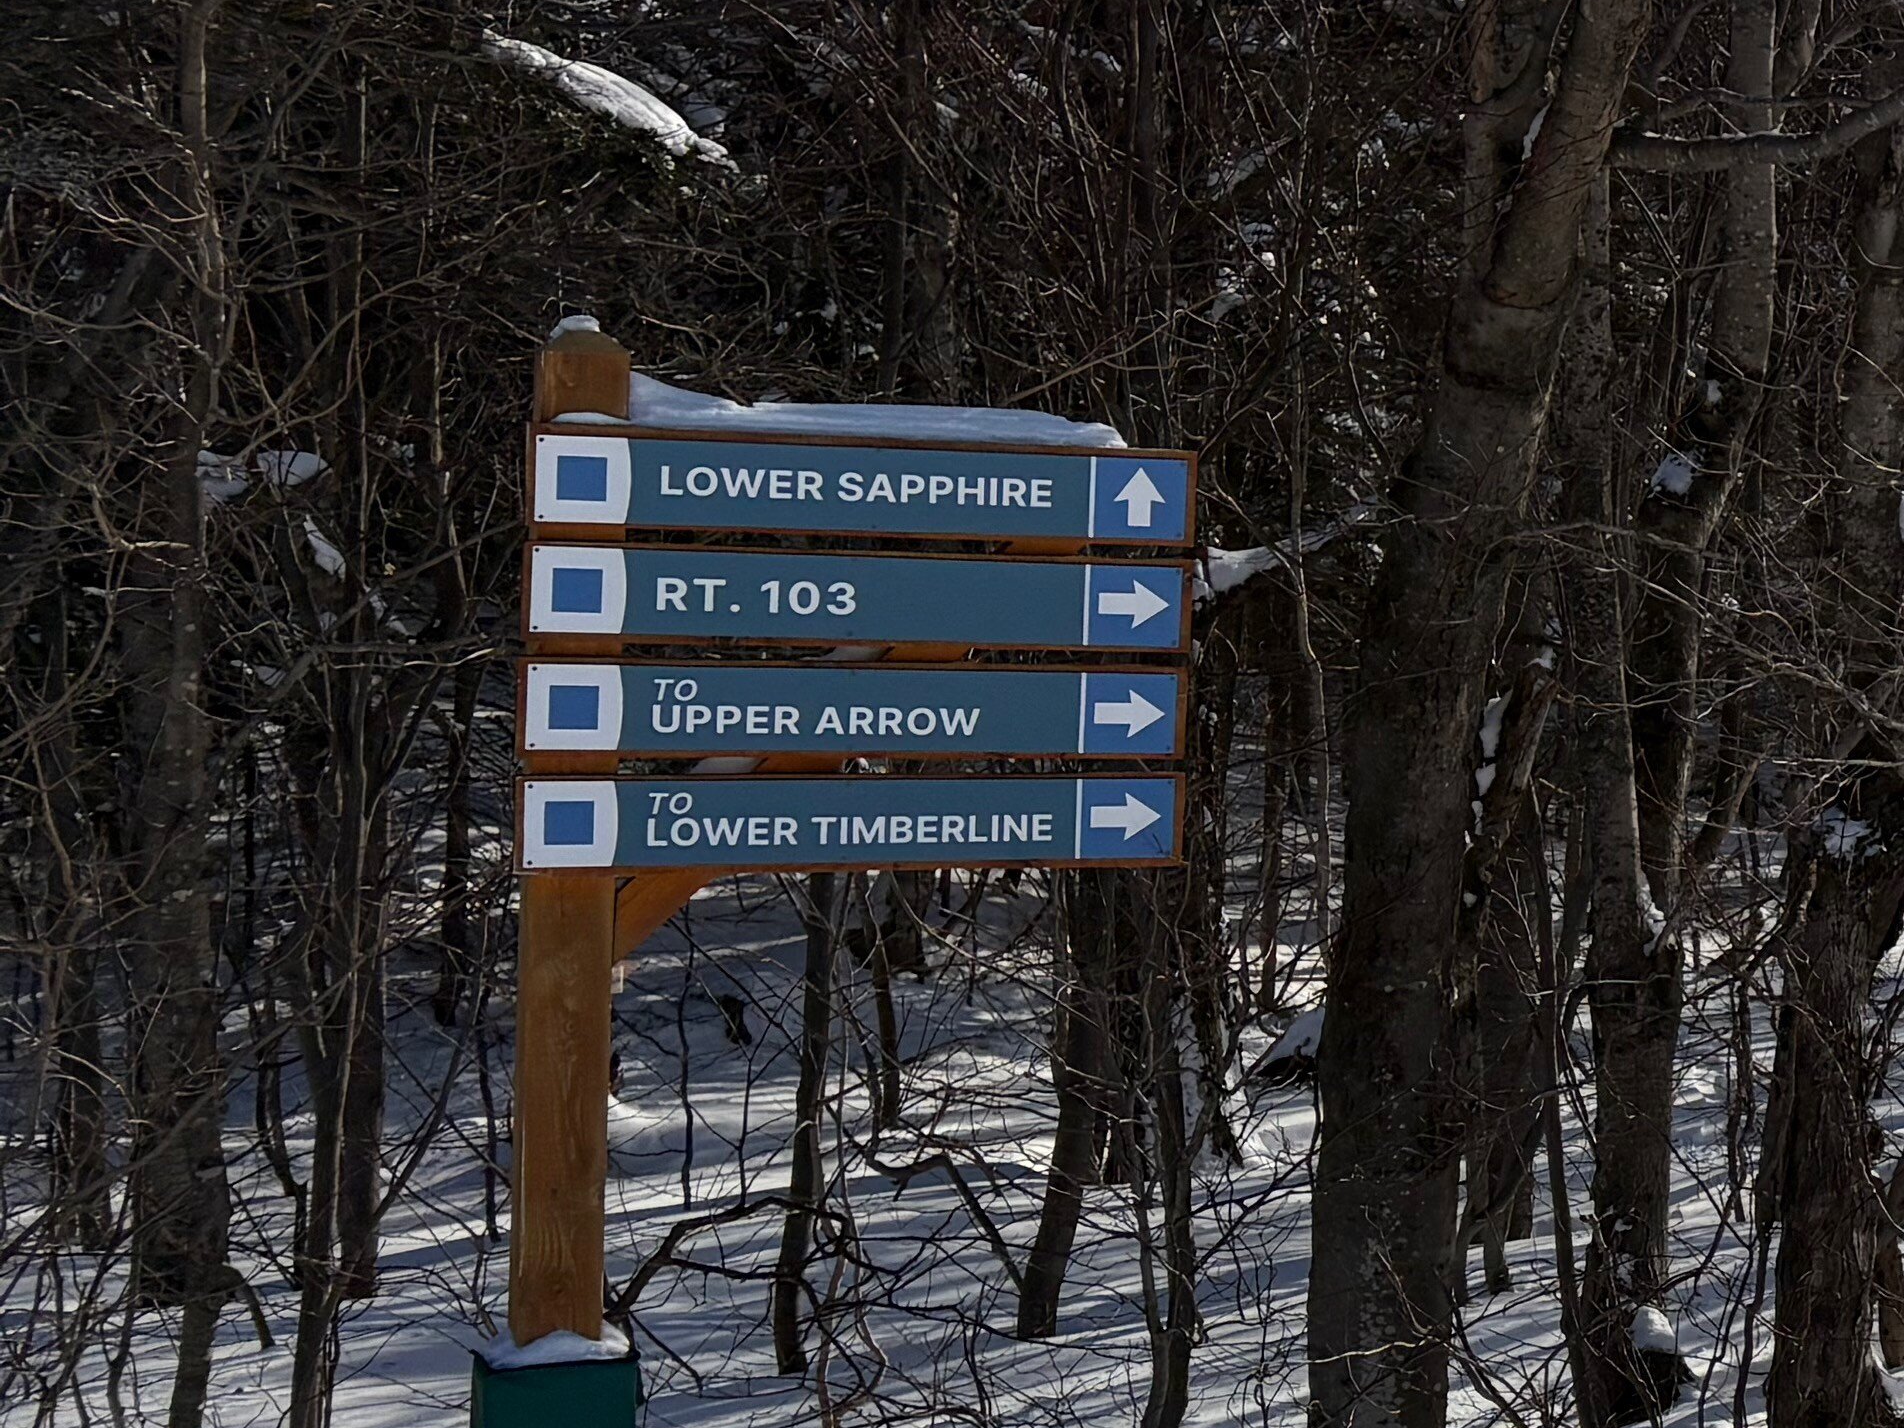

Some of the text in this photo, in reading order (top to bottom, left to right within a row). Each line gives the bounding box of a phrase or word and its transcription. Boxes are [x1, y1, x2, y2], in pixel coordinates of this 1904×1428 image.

[660, 465, 1053, 508] LOWER SAPPHIRE
[656, 577, 856, 615] RT. 103
[654, 678, 698, 701] TO
[652, 704, 981, 736] UPPER ARROW
[648, 792, 693, 815] TO
[647, 814, 1053, 847] LOWER TIMBERLINE
